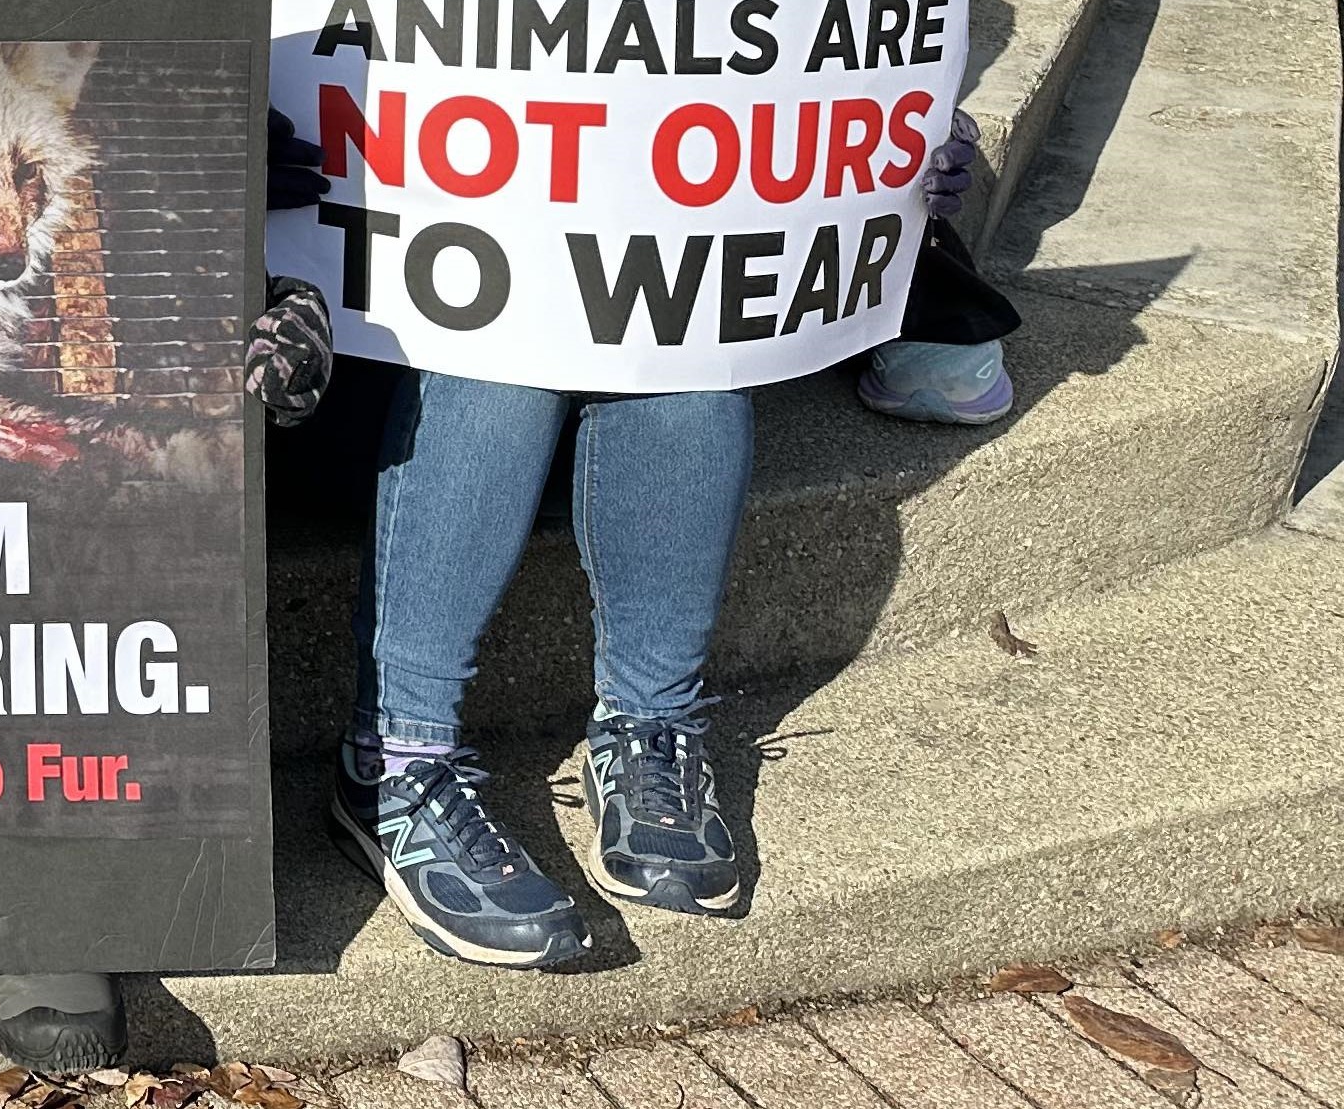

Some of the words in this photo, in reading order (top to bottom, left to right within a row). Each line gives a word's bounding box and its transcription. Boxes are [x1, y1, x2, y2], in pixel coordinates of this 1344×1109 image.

[319, 85, 608, 205] NOT
[651, 90, 934, 209] OURS
[317, 201, 512, 331] TO
[565, 213, 902, 345] WEAR
[26, 742, 142, 803] Fur.
